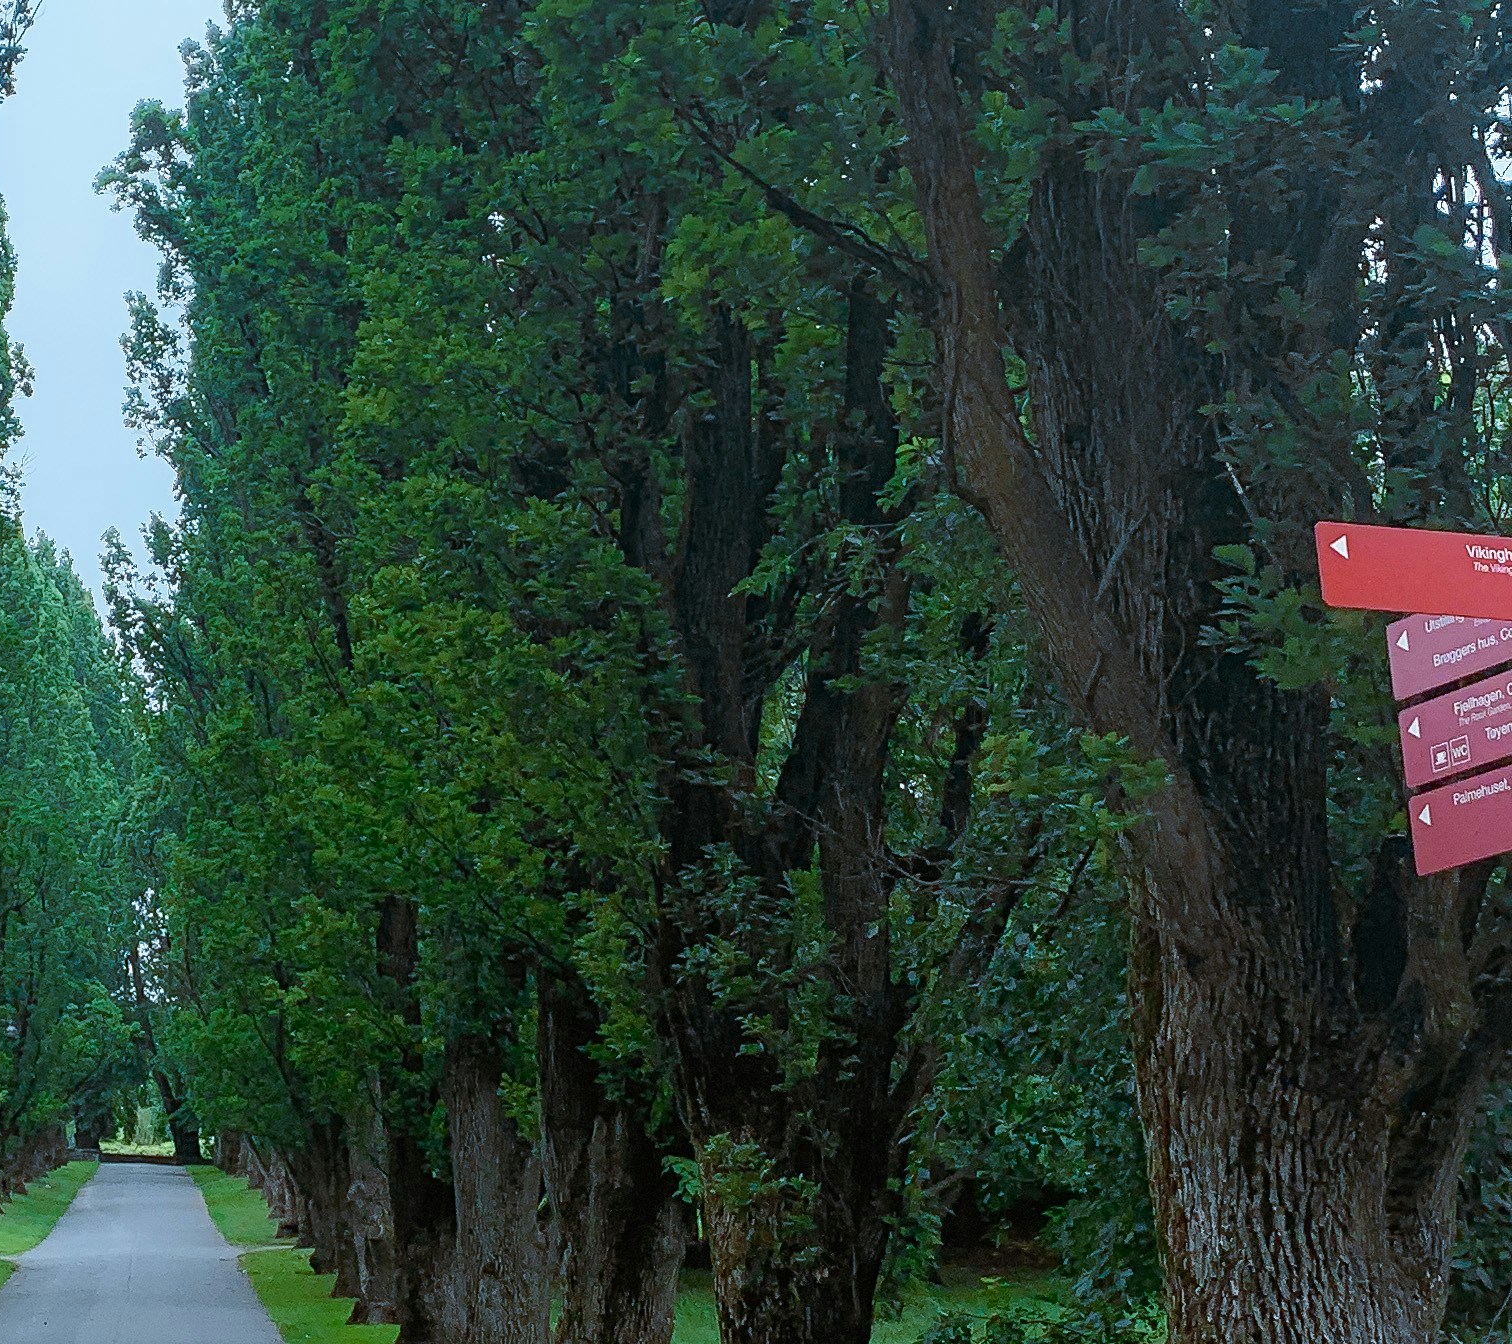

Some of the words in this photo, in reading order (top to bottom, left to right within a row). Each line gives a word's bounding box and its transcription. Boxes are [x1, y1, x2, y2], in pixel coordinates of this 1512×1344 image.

[1473, 561, 1489, 572] The
[1477, 635, 1499, 649] hus,
[1452, 744, 1468, 759] WC
